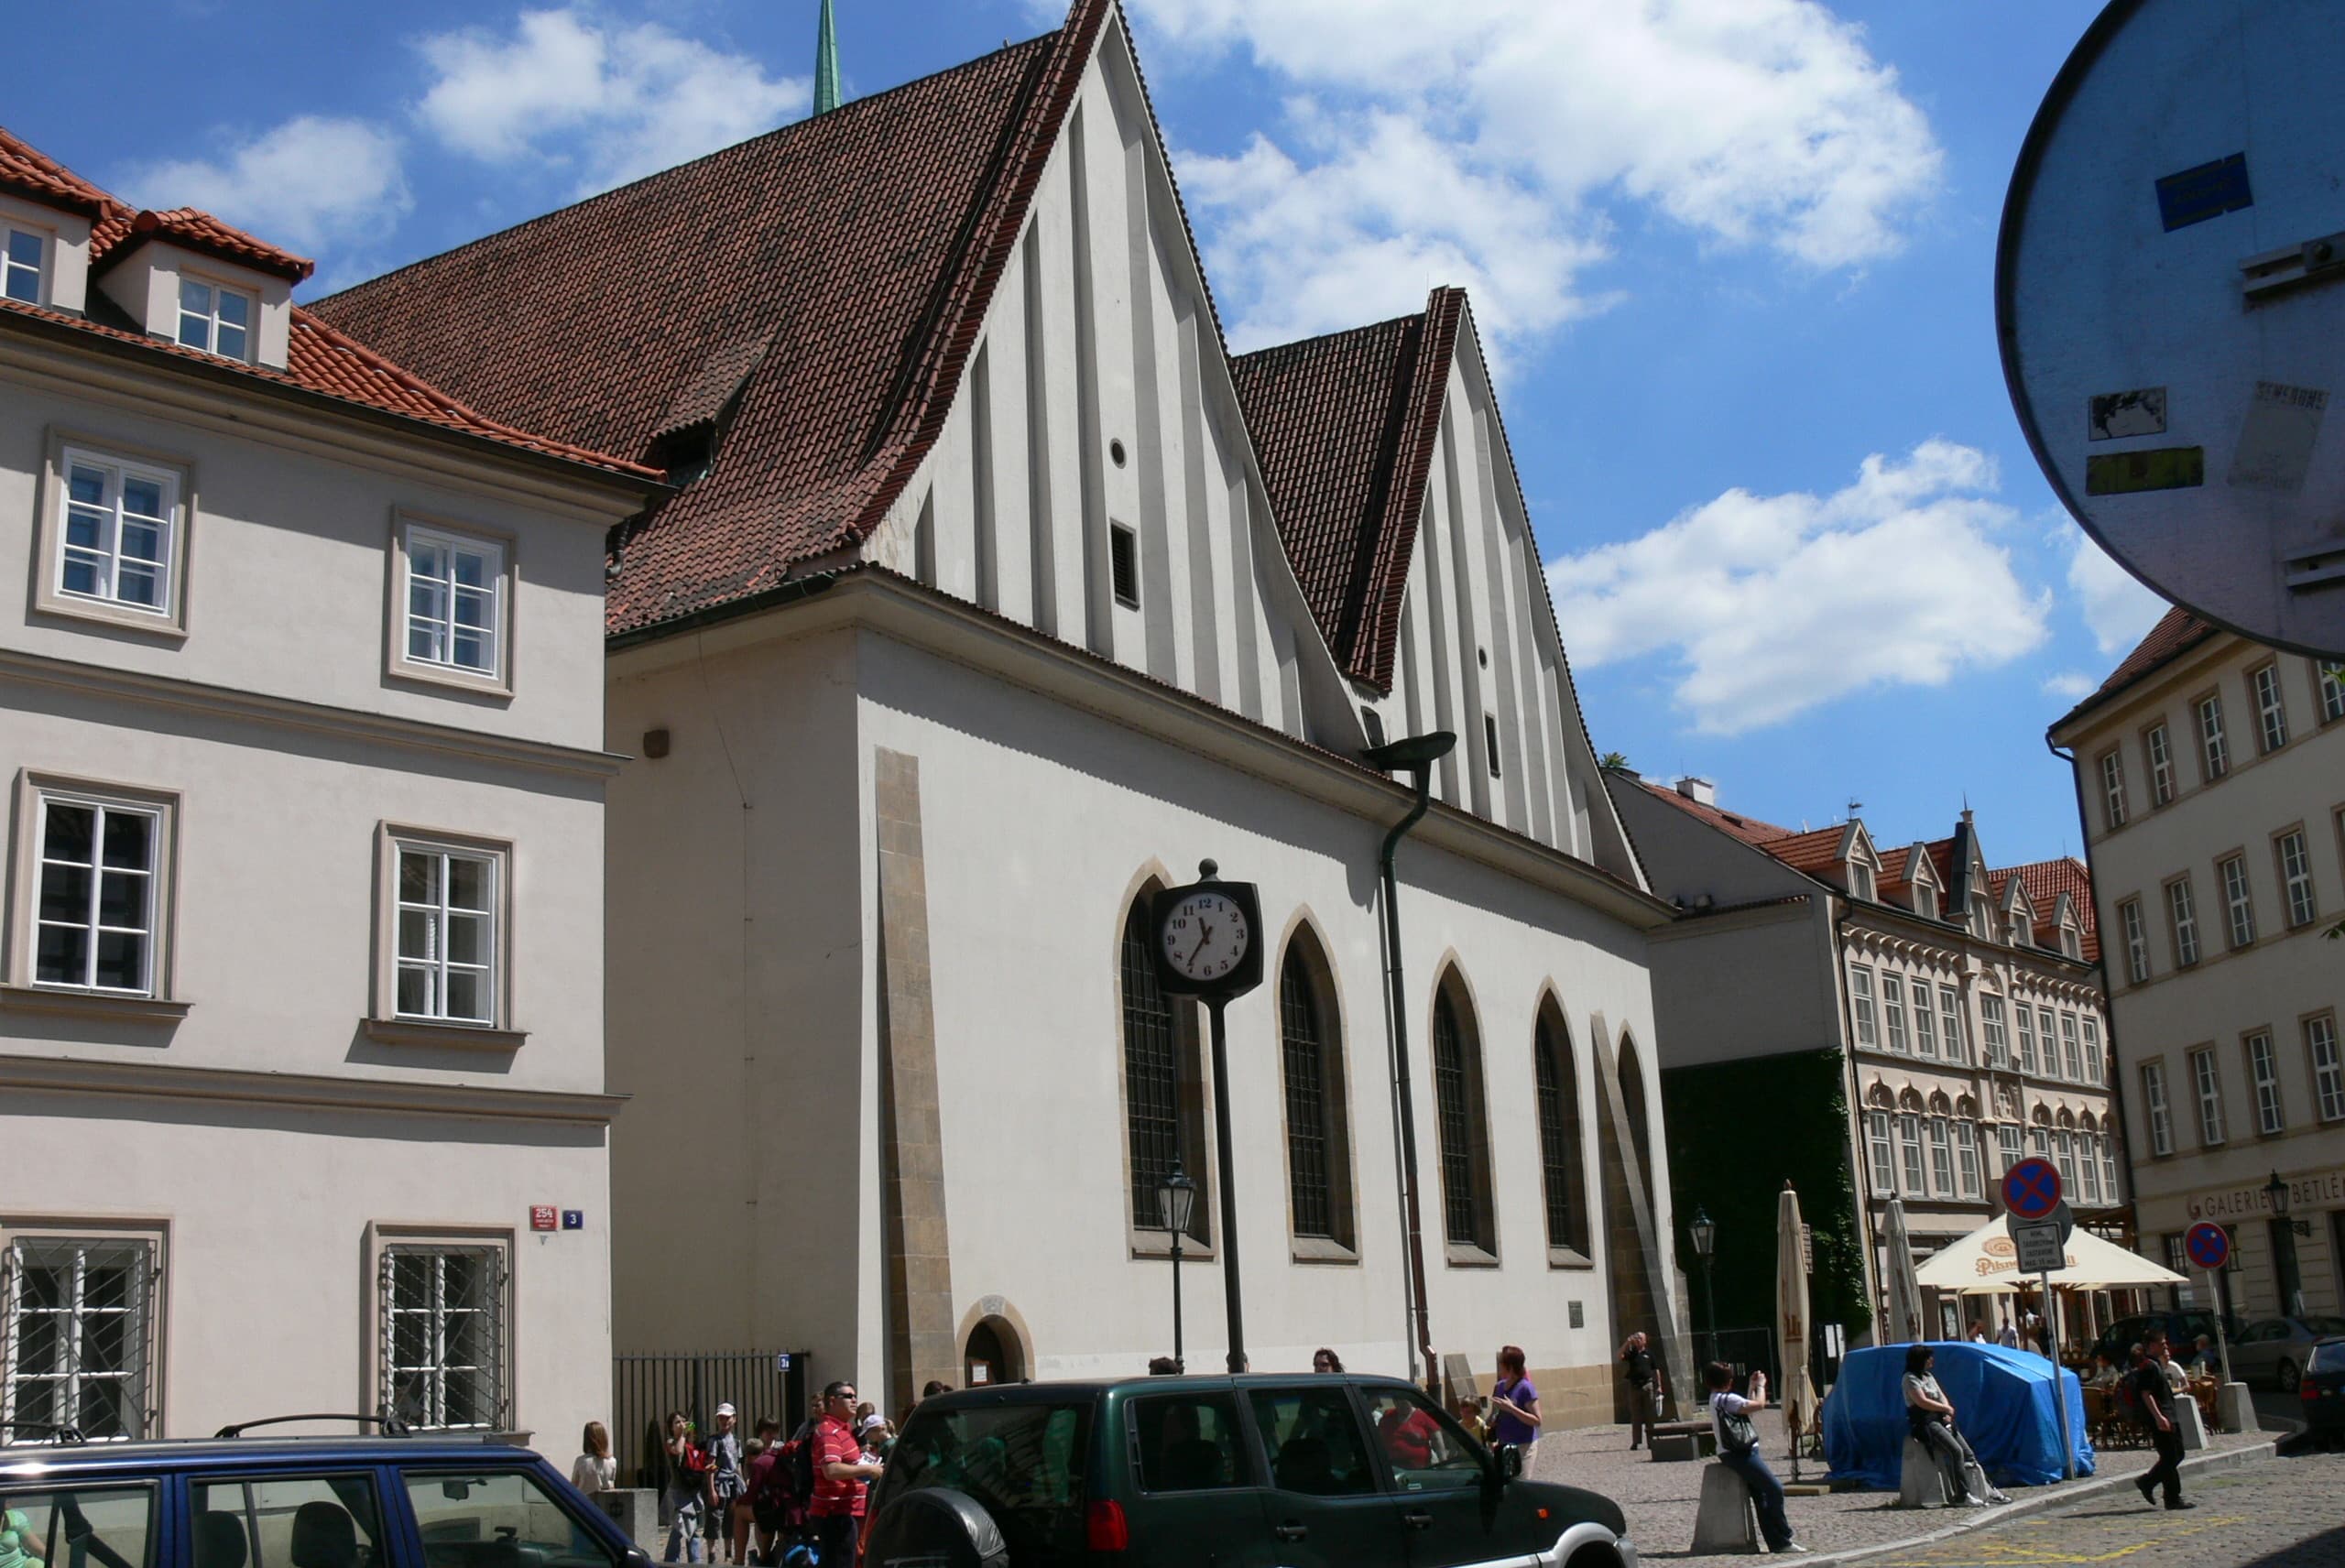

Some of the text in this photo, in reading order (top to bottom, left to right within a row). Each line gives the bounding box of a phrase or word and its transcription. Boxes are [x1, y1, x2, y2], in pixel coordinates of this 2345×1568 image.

[1198, 898, 1212, 909] 12
[1217, 901, 1224, 912] 1
[1183, 905, 1194, 916] 11
[1230, 911, 1238, 923] 2
[1172, 919, 1186, 930] 10
[1236, 929, 1244, 940] 3
[1167, 935, 1176, 946] 9
[1229, 945, 1238, 956] 4
[1172, 952, 1183, 962] 8
[1186, 962, 1195, 974] 7
[1203, 965, 1212, 976] 6
[1219, 961, 1228, 971] 5
[2204, 1188, 2269, 1217] GALERIE
[2292, 1172, 2345, 1204] BETLÉ
[535, 1208, 553, 1218] 254
[569, 1214, 577, 1225] 3
